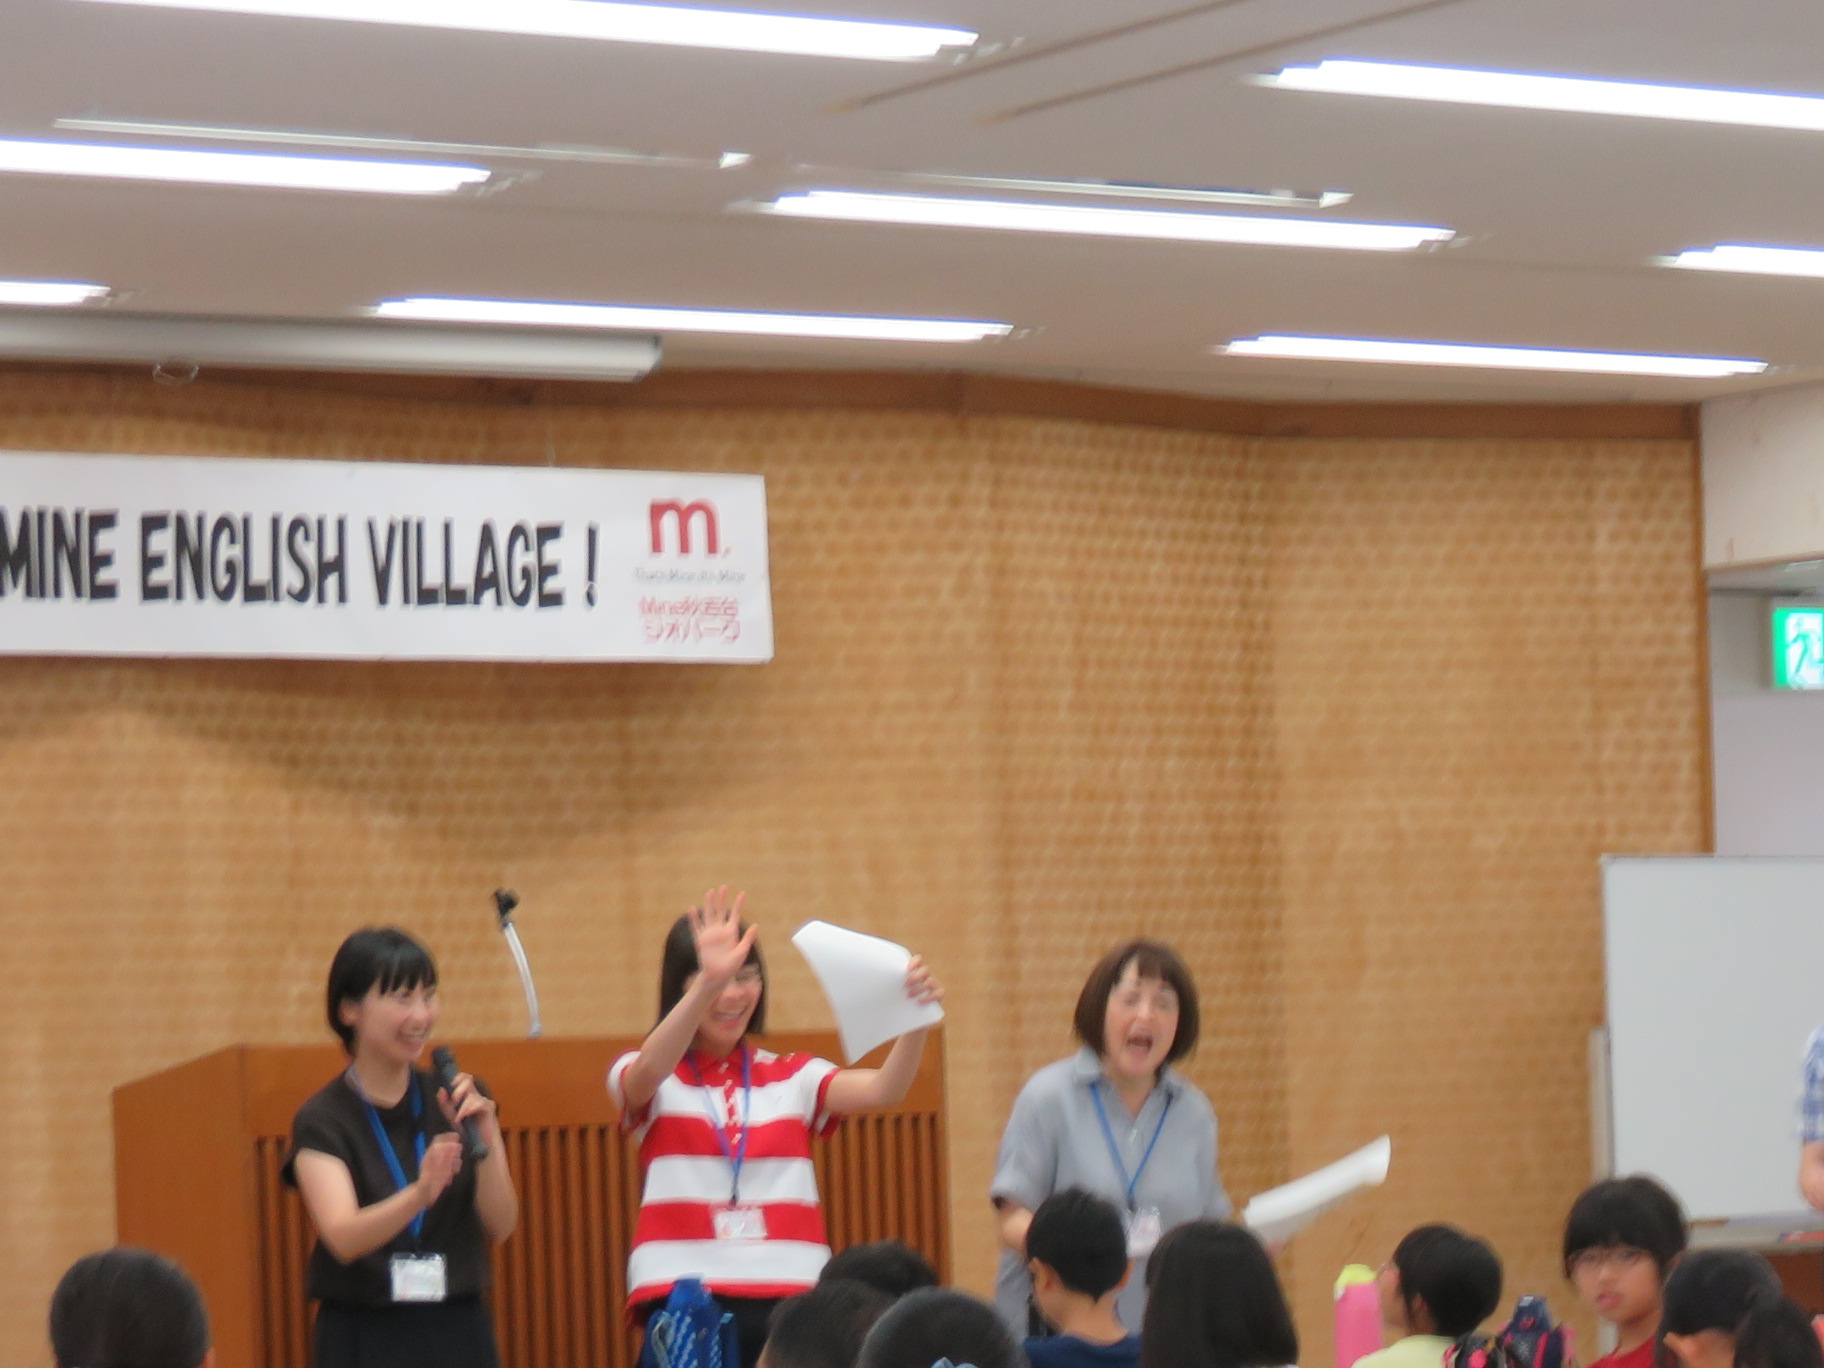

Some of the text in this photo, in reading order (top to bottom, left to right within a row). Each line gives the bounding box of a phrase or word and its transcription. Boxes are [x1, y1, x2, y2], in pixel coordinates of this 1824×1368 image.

[0, 506, 118, 601] MINE
[139, 510, 348, 604] ENGLISH
[366, 516, 564, 608] VILLAGE
